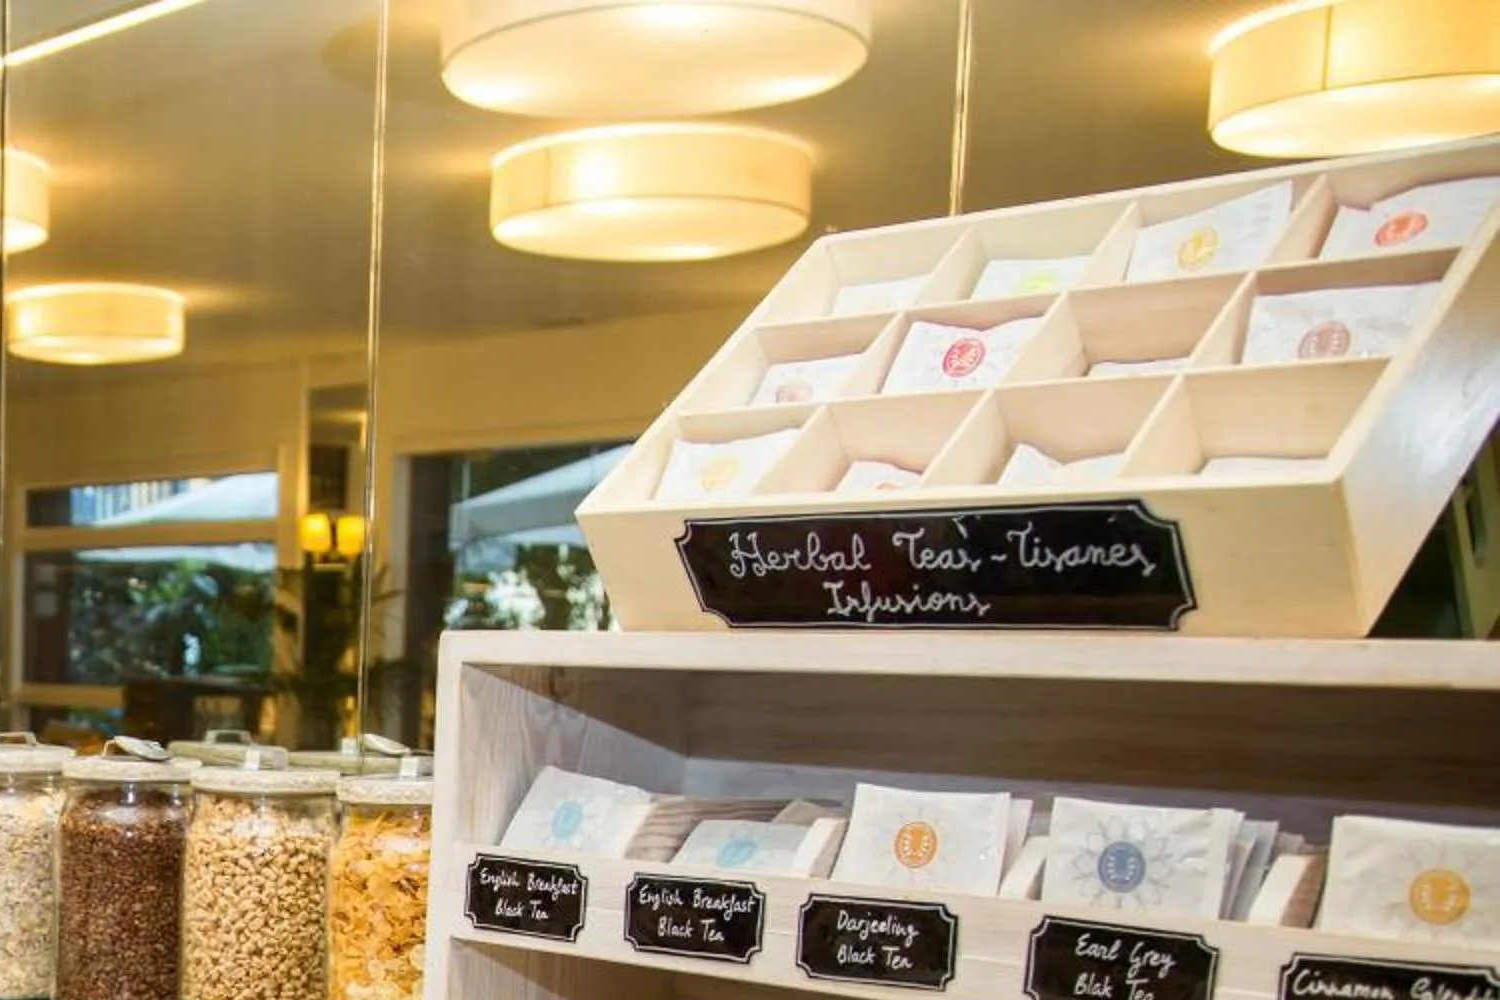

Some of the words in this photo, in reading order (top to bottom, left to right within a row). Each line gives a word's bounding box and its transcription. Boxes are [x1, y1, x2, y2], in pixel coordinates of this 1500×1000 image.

[728, 531, 872, 579] Herbal
[891, 527, 981, 573] Teas
[1006, 521, 1157, 578] Tisanes
[821, 580, 991, 623] Infusions
[479, 867, 521, 891] English
[527, 872, 580, 901] Breakfast
[495, 898, 524, 918] Black
[529, 900, 549, 920] Tea
[639, 884, 684, 911] English
[693, 887, 757, 921] Breakfast
[658, 915, 695, 938] Black
[700, 918, 725, 942] Tea
[837, 909, 920, 948] Darjeeling
[837, 943, 876, 965] Black
[881, 945, 914, 970] Tea
[1075, 933, 1122, 960] Earl
[1127, 941, 1176, 979] Grey
[1292, 969, 1394, 1000] Cinnamon
